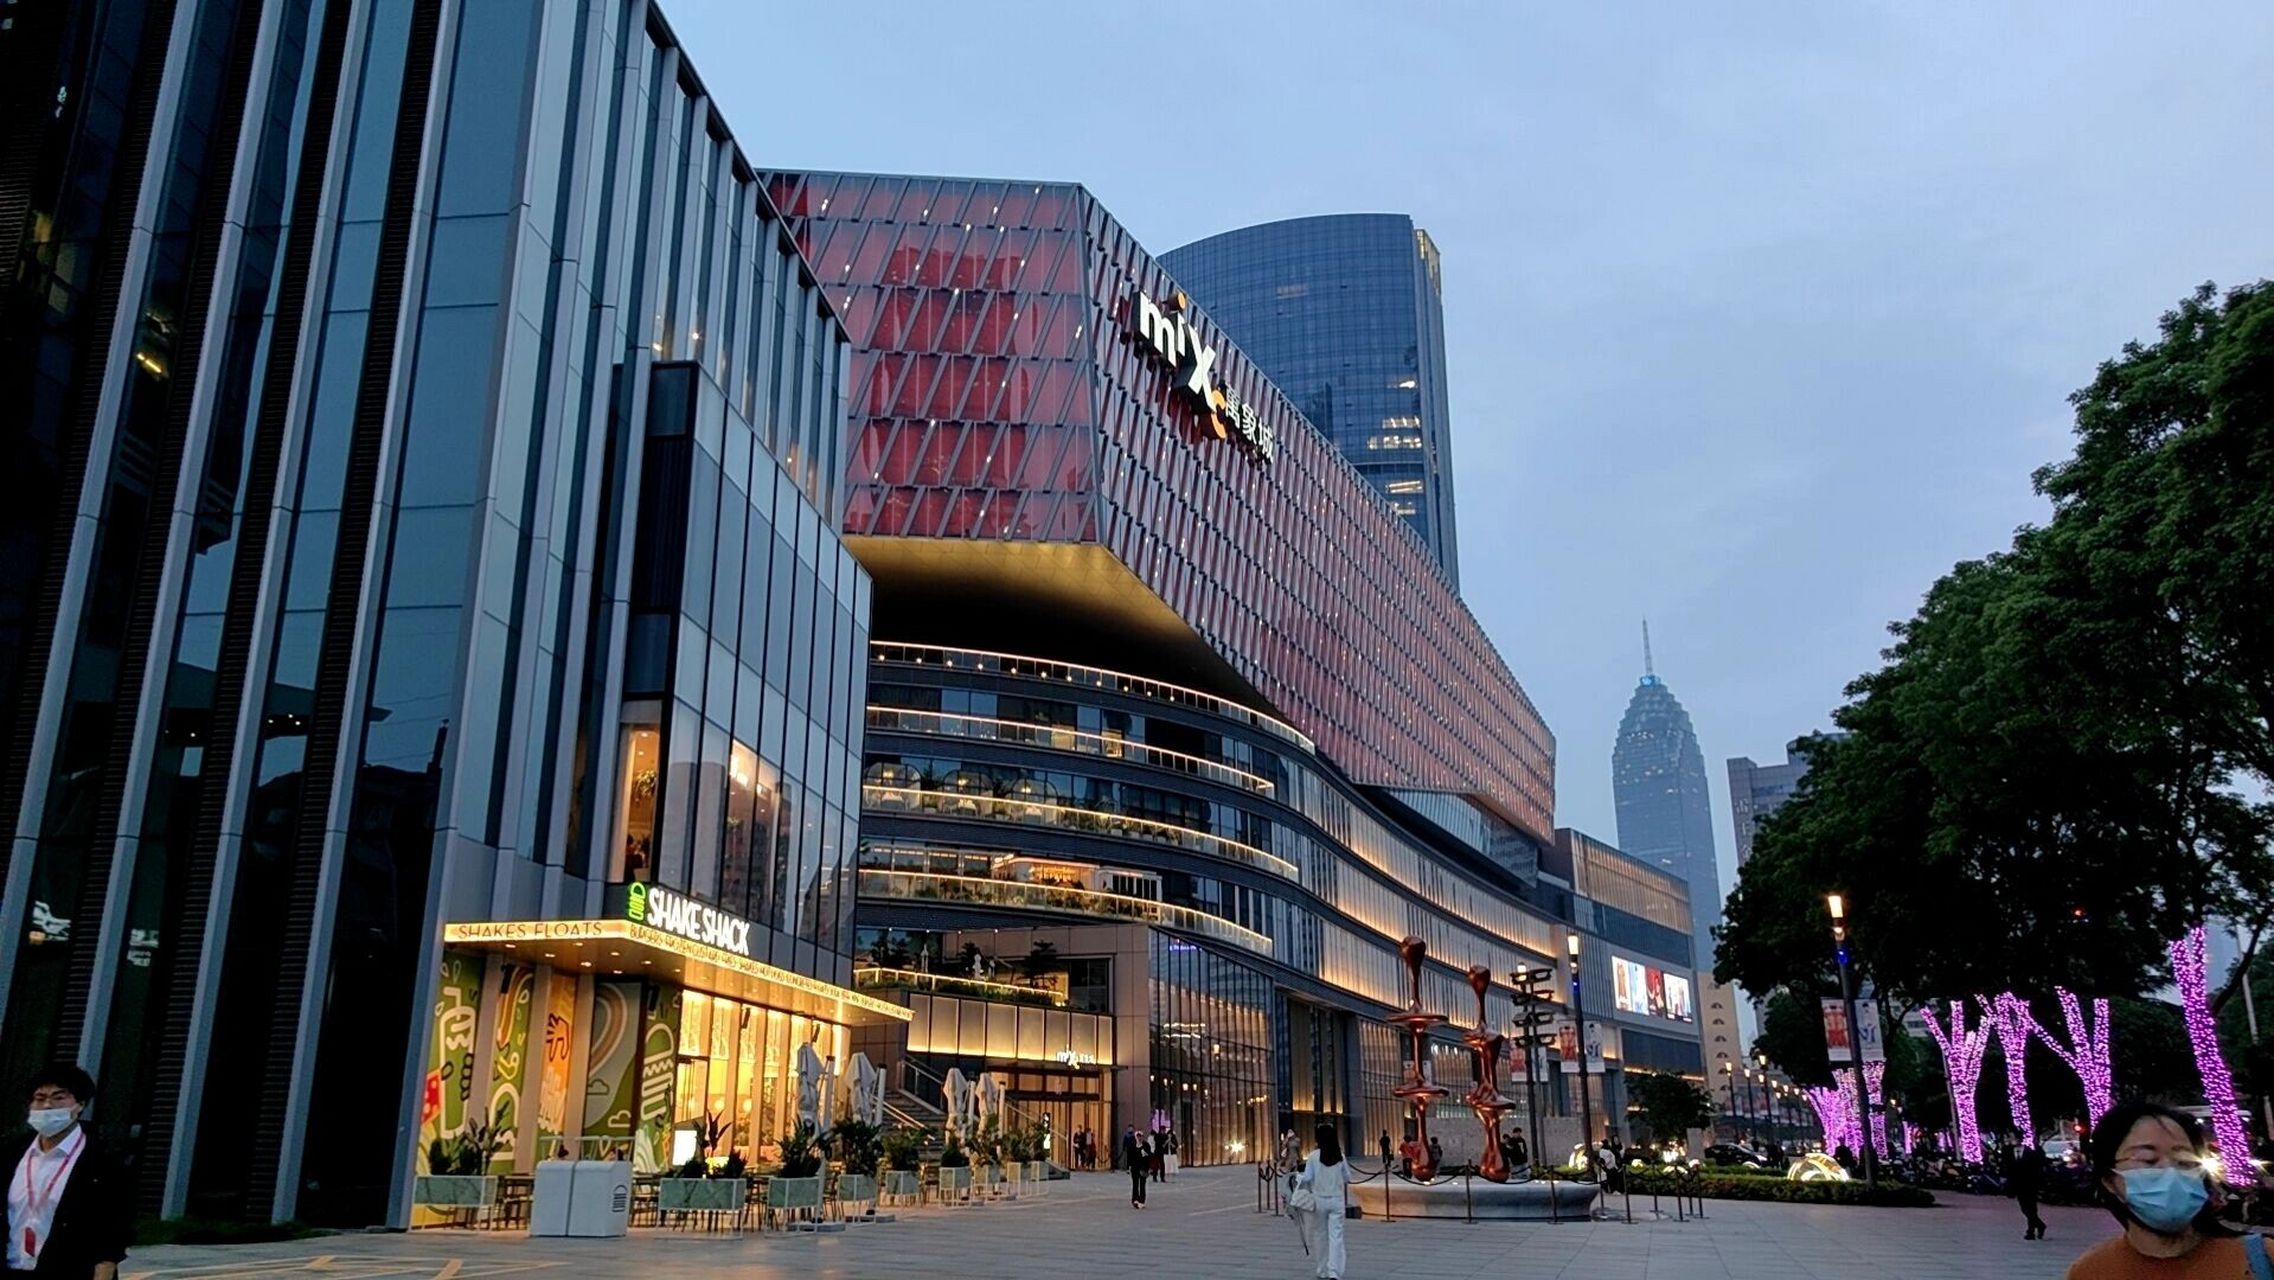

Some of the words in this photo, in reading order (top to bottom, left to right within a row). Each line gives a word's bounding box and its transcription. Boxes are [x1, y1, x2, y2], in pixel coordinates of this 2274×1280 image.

[457, 923, 526, 940] SHAKES
[534, 921, 603, 938] FLOATS
[647, 887, 702, 941] SHAKE
[701, 907, 750, 957] SHACK
